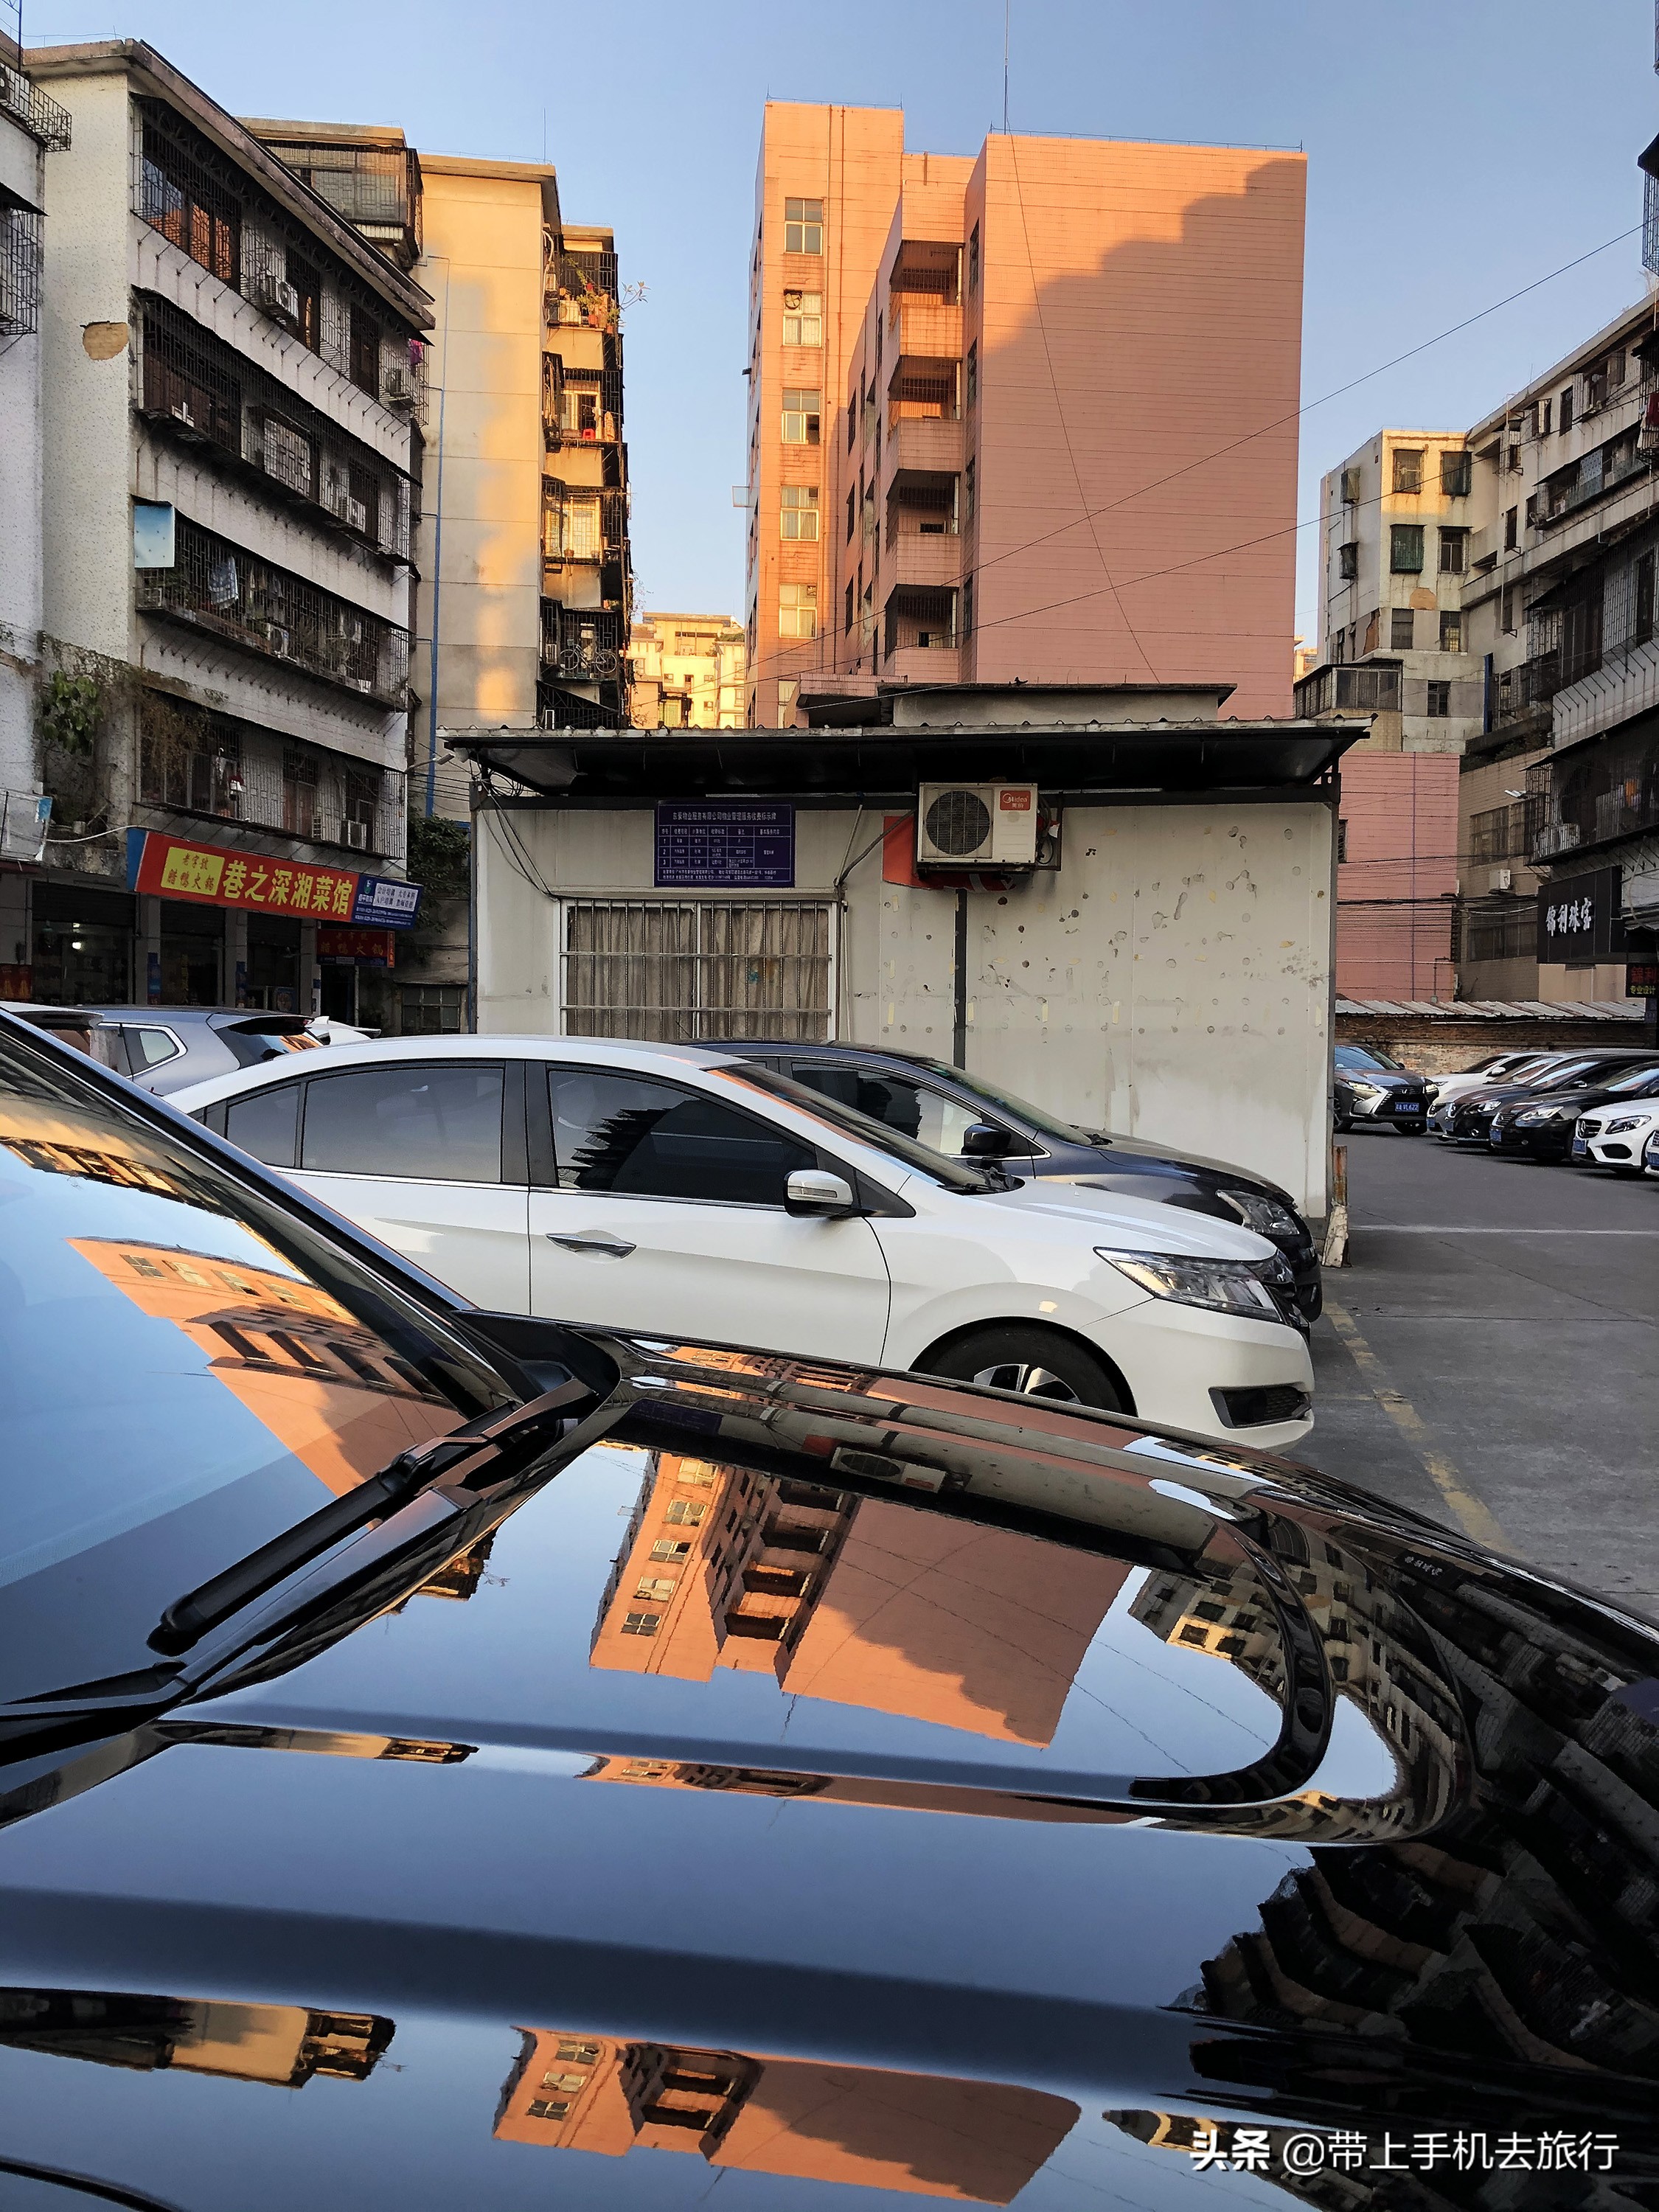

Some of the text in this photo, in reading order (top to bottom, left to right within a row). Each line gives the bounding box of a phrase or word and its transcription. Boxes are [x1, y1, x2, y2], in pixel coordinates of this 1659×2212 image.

[223, 859, 352, 915] 巷之深湘菜馆
[1630, 985, 1656, 995] 专业设计
